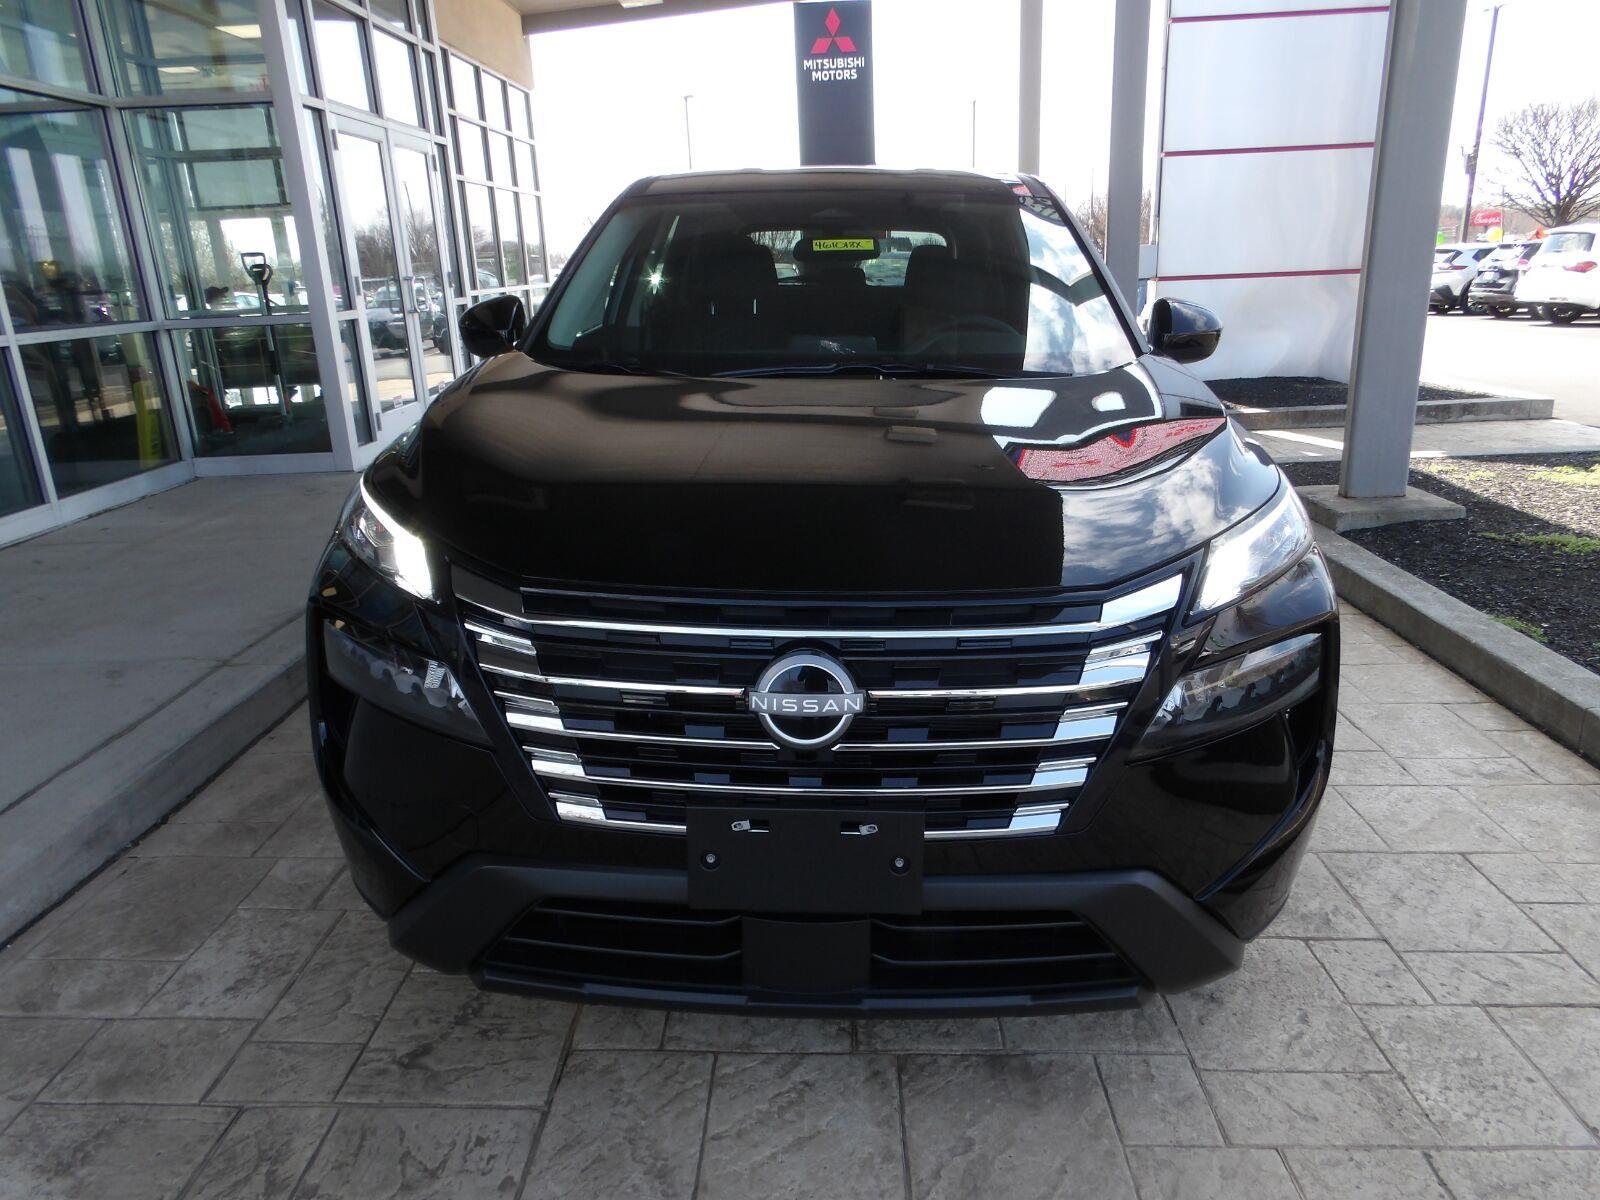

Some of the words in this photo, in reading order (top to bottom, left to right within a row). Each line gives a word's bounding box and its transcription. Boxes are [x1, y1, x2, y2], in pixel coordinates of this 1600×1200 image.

[803, 57, 864, 70] MITSUBISHI
[811, 69, 857, 81] MOTORS
[751, 696, 860, 712] NISSAN
